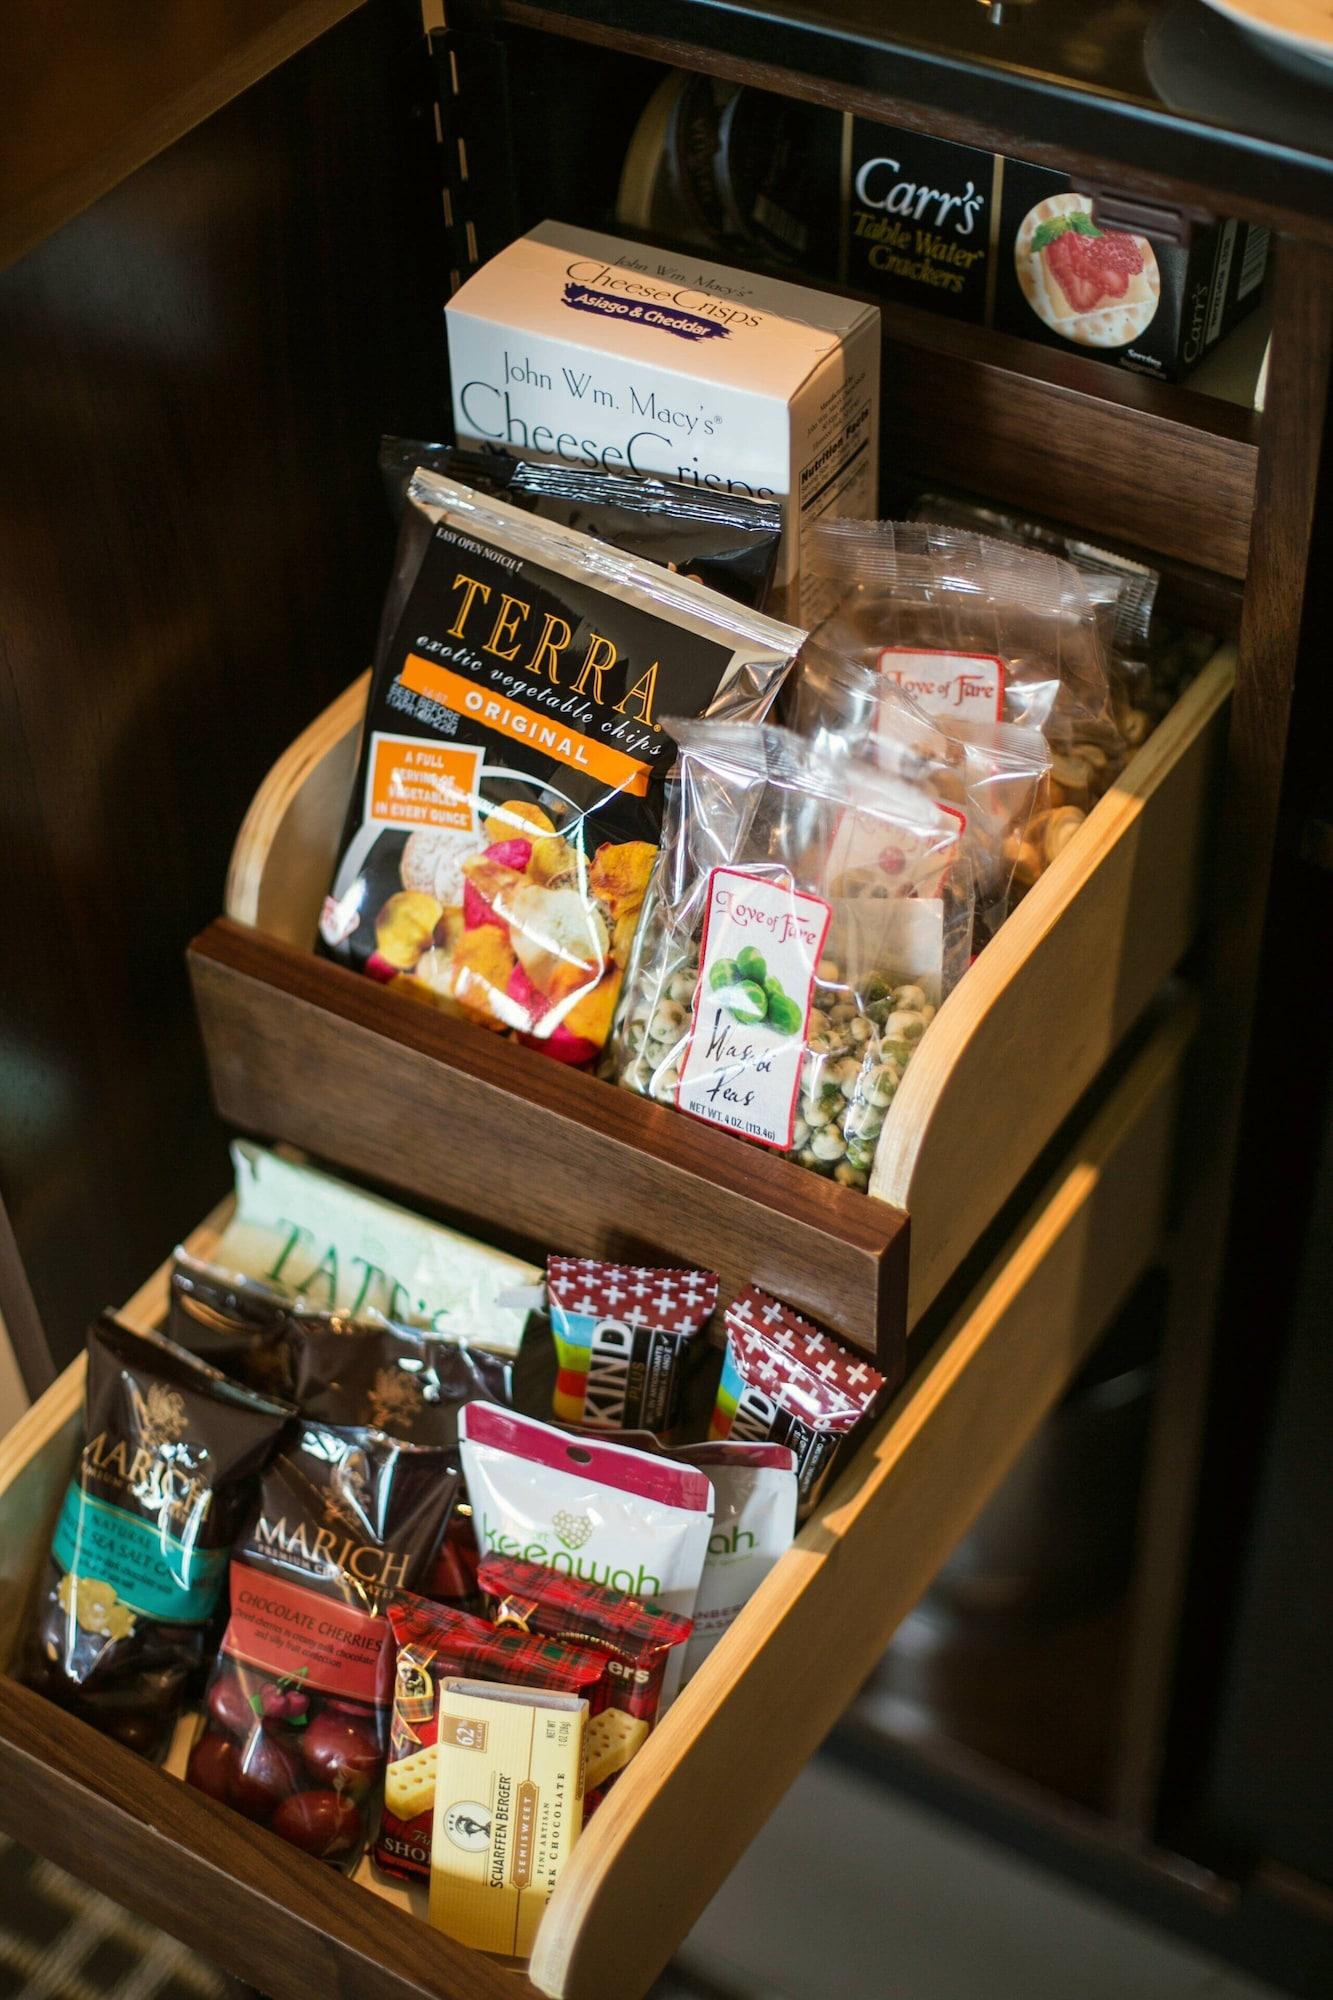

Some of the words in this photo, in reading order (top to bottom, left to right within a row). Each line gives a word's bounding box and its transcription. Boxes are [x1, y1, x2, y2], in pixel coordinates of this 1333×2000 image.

[856, 158, 984, 235] Carr's
[853, 212, 912, 249] Table
[915, 230, 985, 269] Water
[613, 256, 650, 272] John
[657, 264, 686, 283] Wm.
[868, 244, 965, 293] Crackers
[566, 261, 763, 327] CheeseCrisps
[575, 293, 628, 314] Asiago
[629, 306, 643, 319] &
[644, 310, 711, 336] Cheddar
[1183, 280, 1208, 363] Carr's
[504, 352, 552, 390] John
[562, 368, 620, 409] Wm.
[800, 437, 844, 485] Nutrition
[436, 527, 458, 543] EASY
[457, 537, 482, 554] OPEN
[482, 547, 517, 570] NOTCH
[416, 635, 482, 671] exotic
[491, 667, 593, 722] vegetable
[601, 720, 661, 756] chips
[937, 681, 951, 699] of
[952, 675, 995, 706] Fare
[464, 691, 589, 765] ORIGINAL
[405, 752, 413, 763] A
[416, 752, 444, 768] FULL
[392, 804, 431, 820] EVERY
[715, 890, 766, 926] Love
[767, 916, 779, 933] of
[689, 1101, 706, 1116] NET
[707, 1107, 724, 1124] WT.
[730, 1115, 746, 1131] OZ.
[584, 1319, 633, 1430] KIND
[254, 1515, 412, 1588] MARICH
[239, 1590, 315, 1632] CHOCOLATE
[317, 1621, 384, 1653] CHERRIES
[335, 1644, 376, 1666] chocolate
[496, 1775, 512, 1821] BERGER
[552, 1772, 566, 1860] CHOCOLATE
[517, 1797, 533, 1873] SEMISWEET
[539, 1802, 550, 1848] ARTISAN
[490, 1821, 508, 1889] SCHARFFEN
[536, 1851, 545, 1874] FINE
